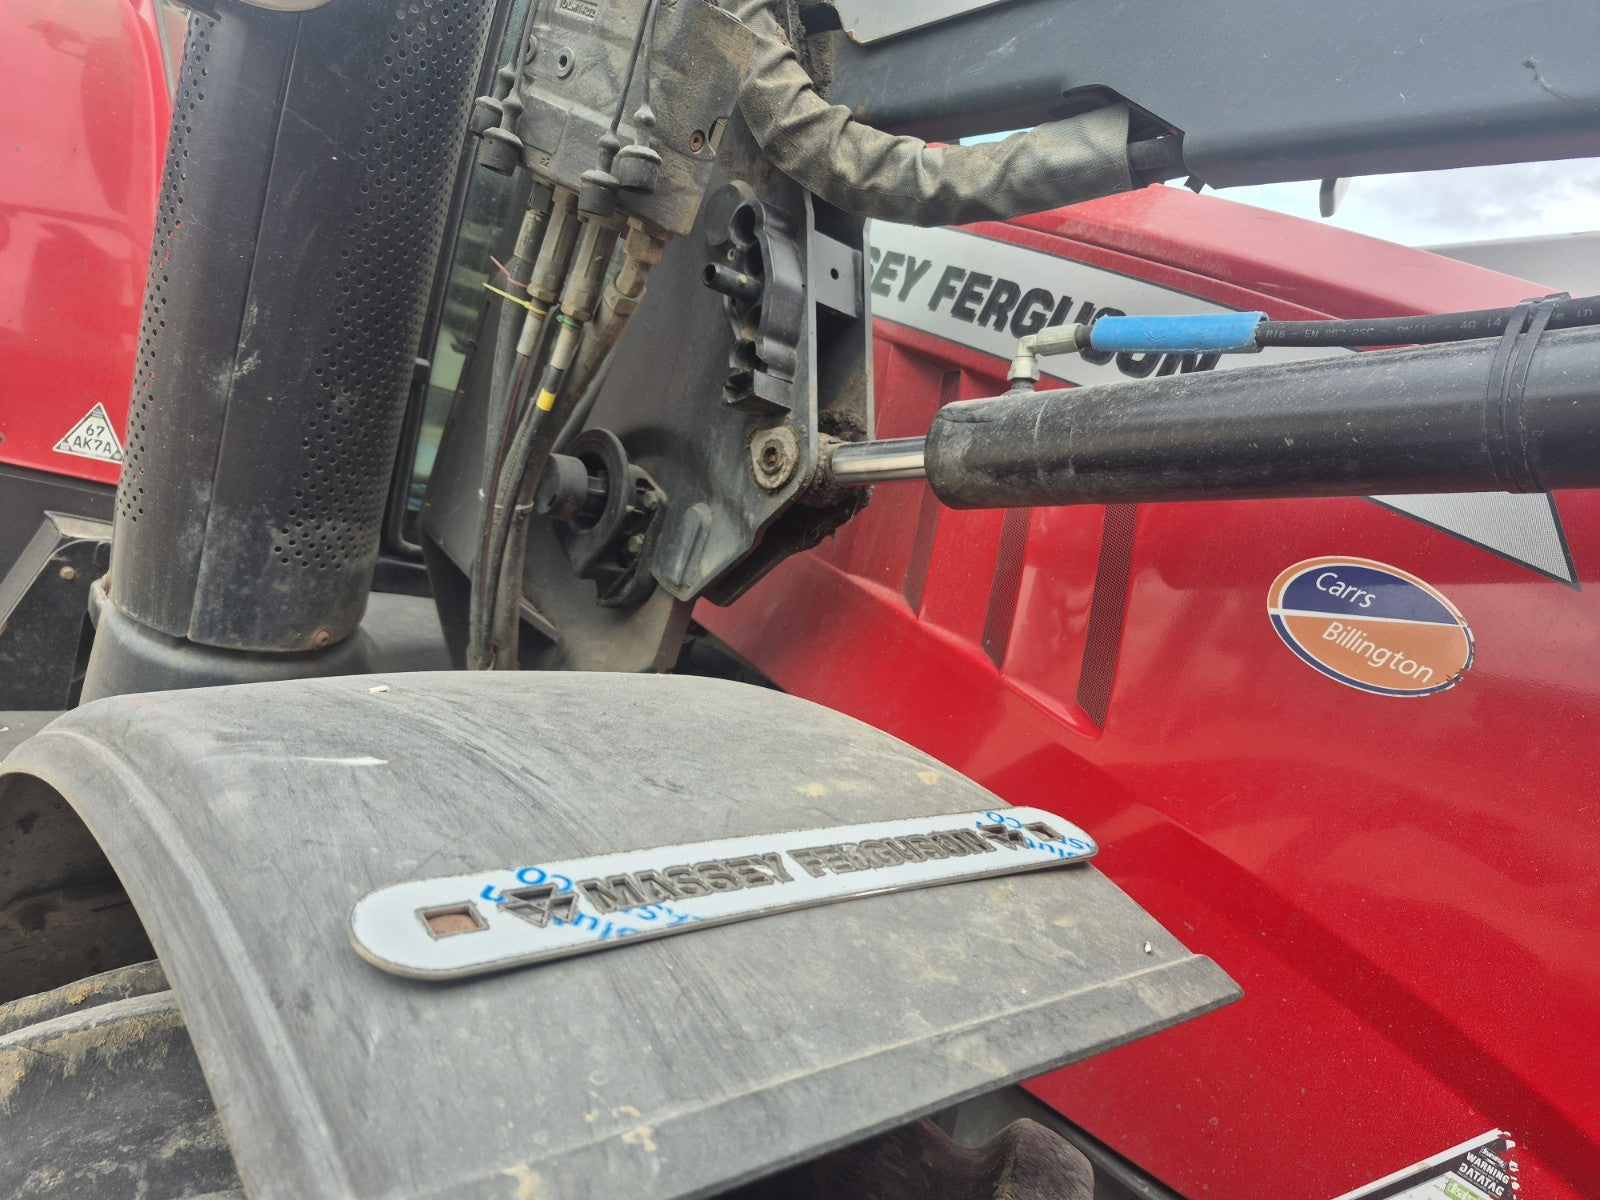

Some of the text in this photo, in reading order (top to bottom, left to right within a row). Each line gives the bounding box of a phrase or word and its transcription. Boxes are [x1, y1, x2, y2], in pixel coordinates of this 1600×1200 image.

[1304, 329, 1319, 338] EN
[73, 436, 112, 454] AK7A
[86, 425, 105, 437] 67
[1315, 572, 1376, 608] Carrs
[1322, 621, 1434, 683] Billington
[576, 852, 795, 914] MASSEY
[787, 828, 998, 878] FERGUSON
[1458, 1162, 1505, 1197] DATATAG
[1466, 1151, 1511, 1185] WARNING
